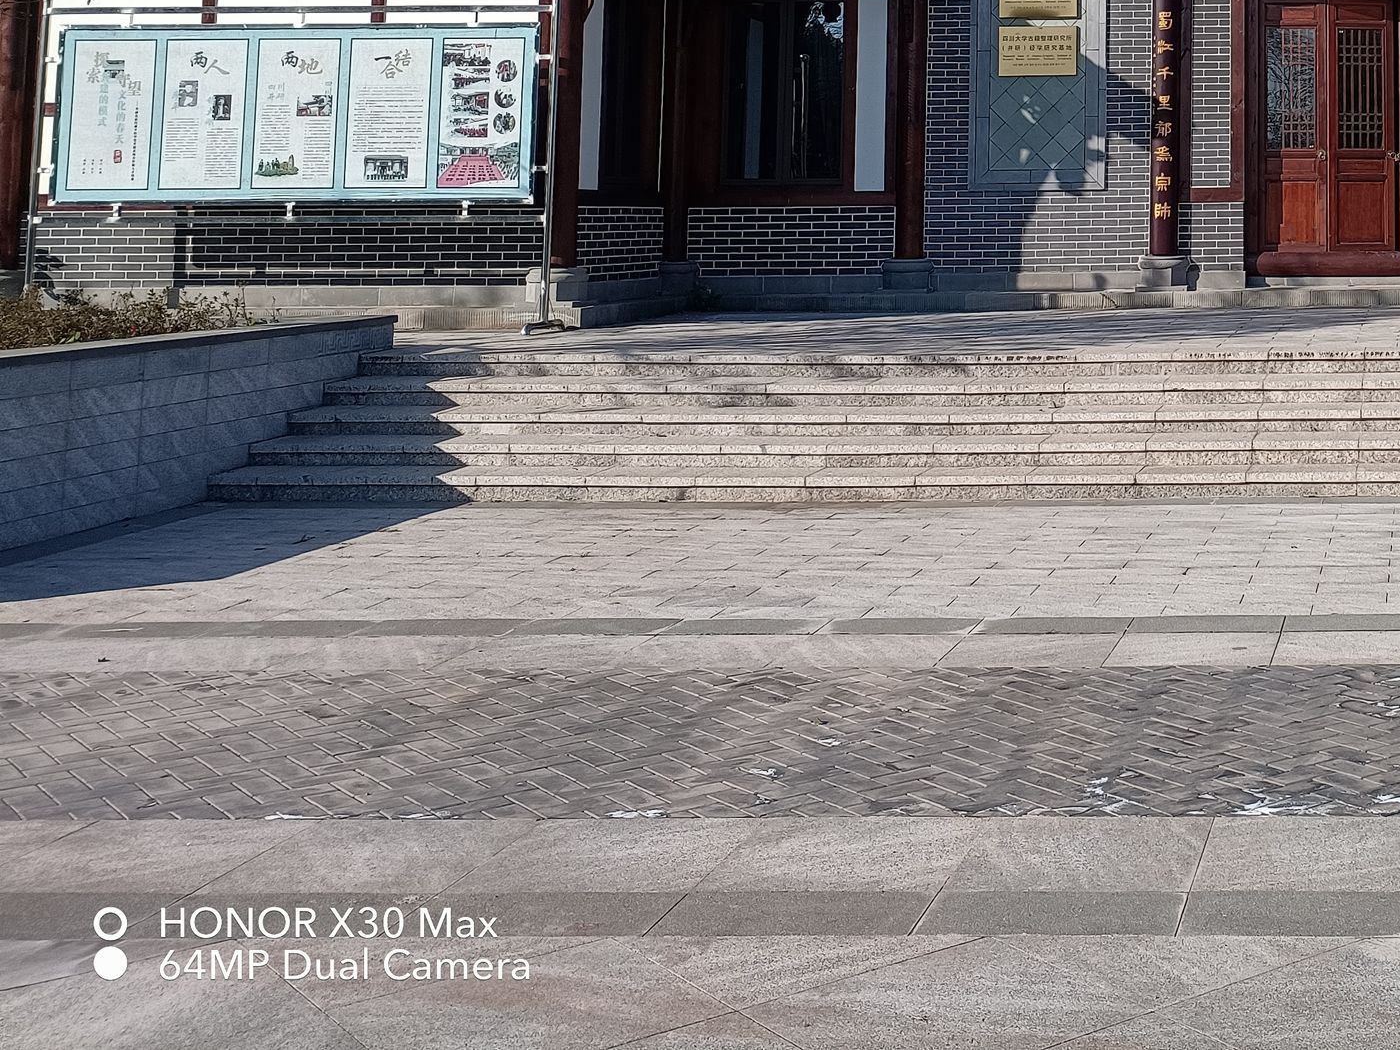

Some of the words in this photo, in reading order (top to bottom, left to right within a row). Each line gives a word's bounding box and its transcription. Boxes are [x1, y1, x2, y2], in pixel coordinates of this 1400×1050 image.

[189, 50, 231, 76] 两人
[281, 50, 324, 76] 两地
[114, 88, 127, 145] 文化的春天
